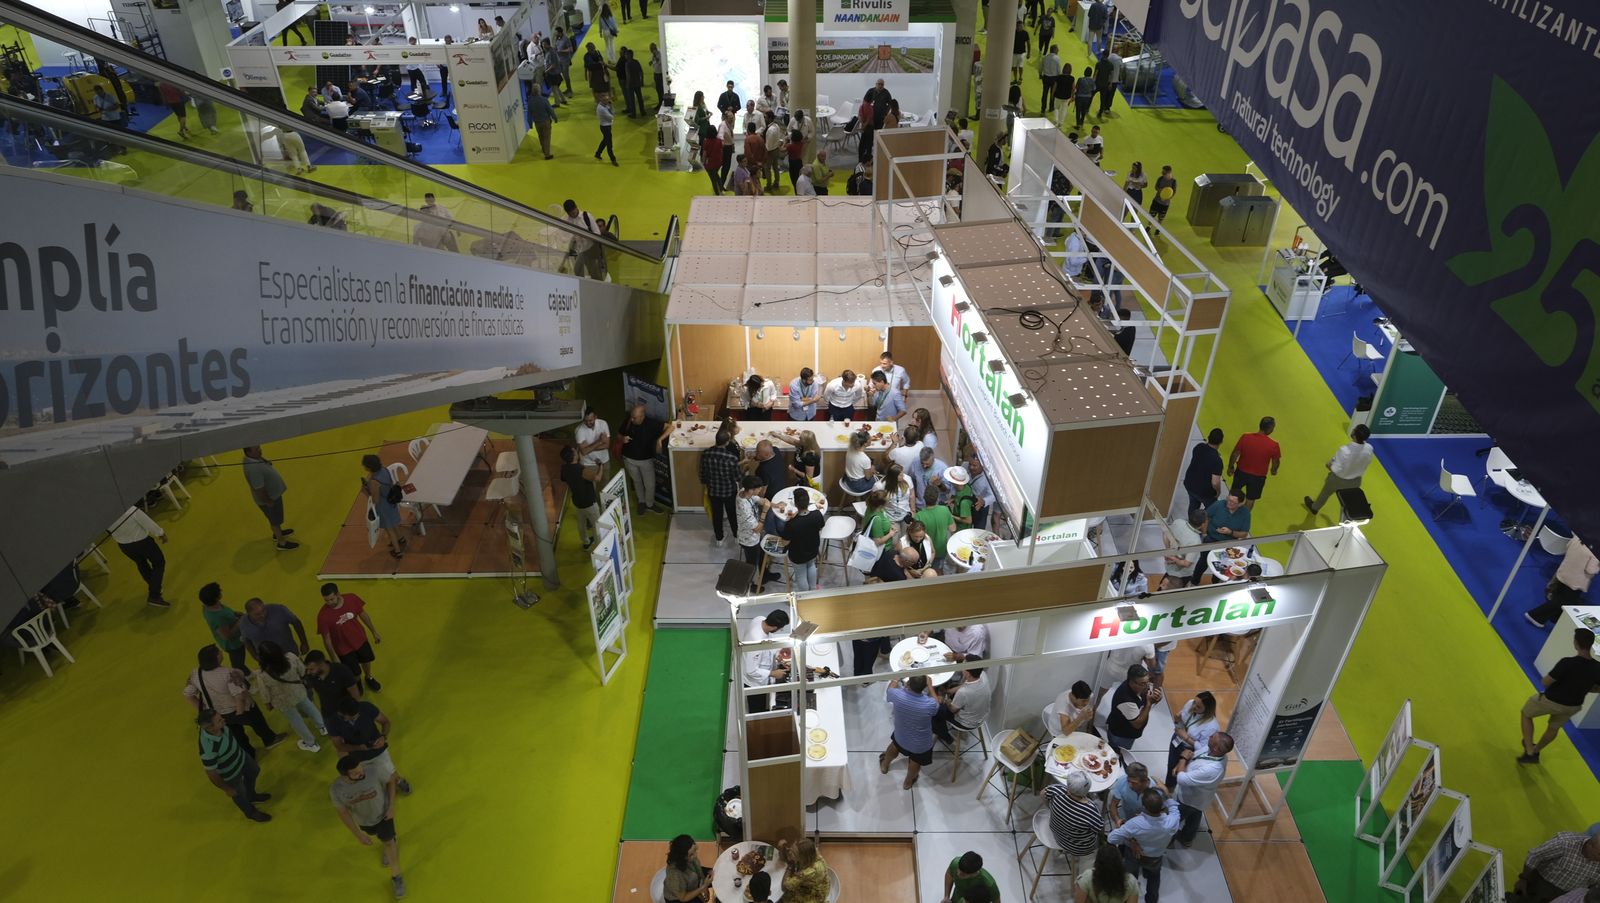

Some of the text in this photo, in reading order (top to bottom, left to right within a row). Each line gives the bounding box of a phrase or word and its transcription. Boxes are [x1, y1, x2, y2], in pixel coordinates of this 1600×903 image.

[834, 13, 900, 23] NAANDANJAIN
[852, 0, 893, 9] Rivulis
[832, 53, 869, 61] INNOVACIÓN
[1231, 90, 1341, 223] natural technology
[259, 261, 524, 310] Especialistas en la financiación a medida de
[548, 287, 573, 316] cajasur
[261, 307, 524, 348] transmisión y reconversión de fincas rústicas
[950, 293, 1025, 449] Hortalan
[1034, 532, 1078, 542] Hortalan
[1089, 598, 1277, 640] Hortalan
